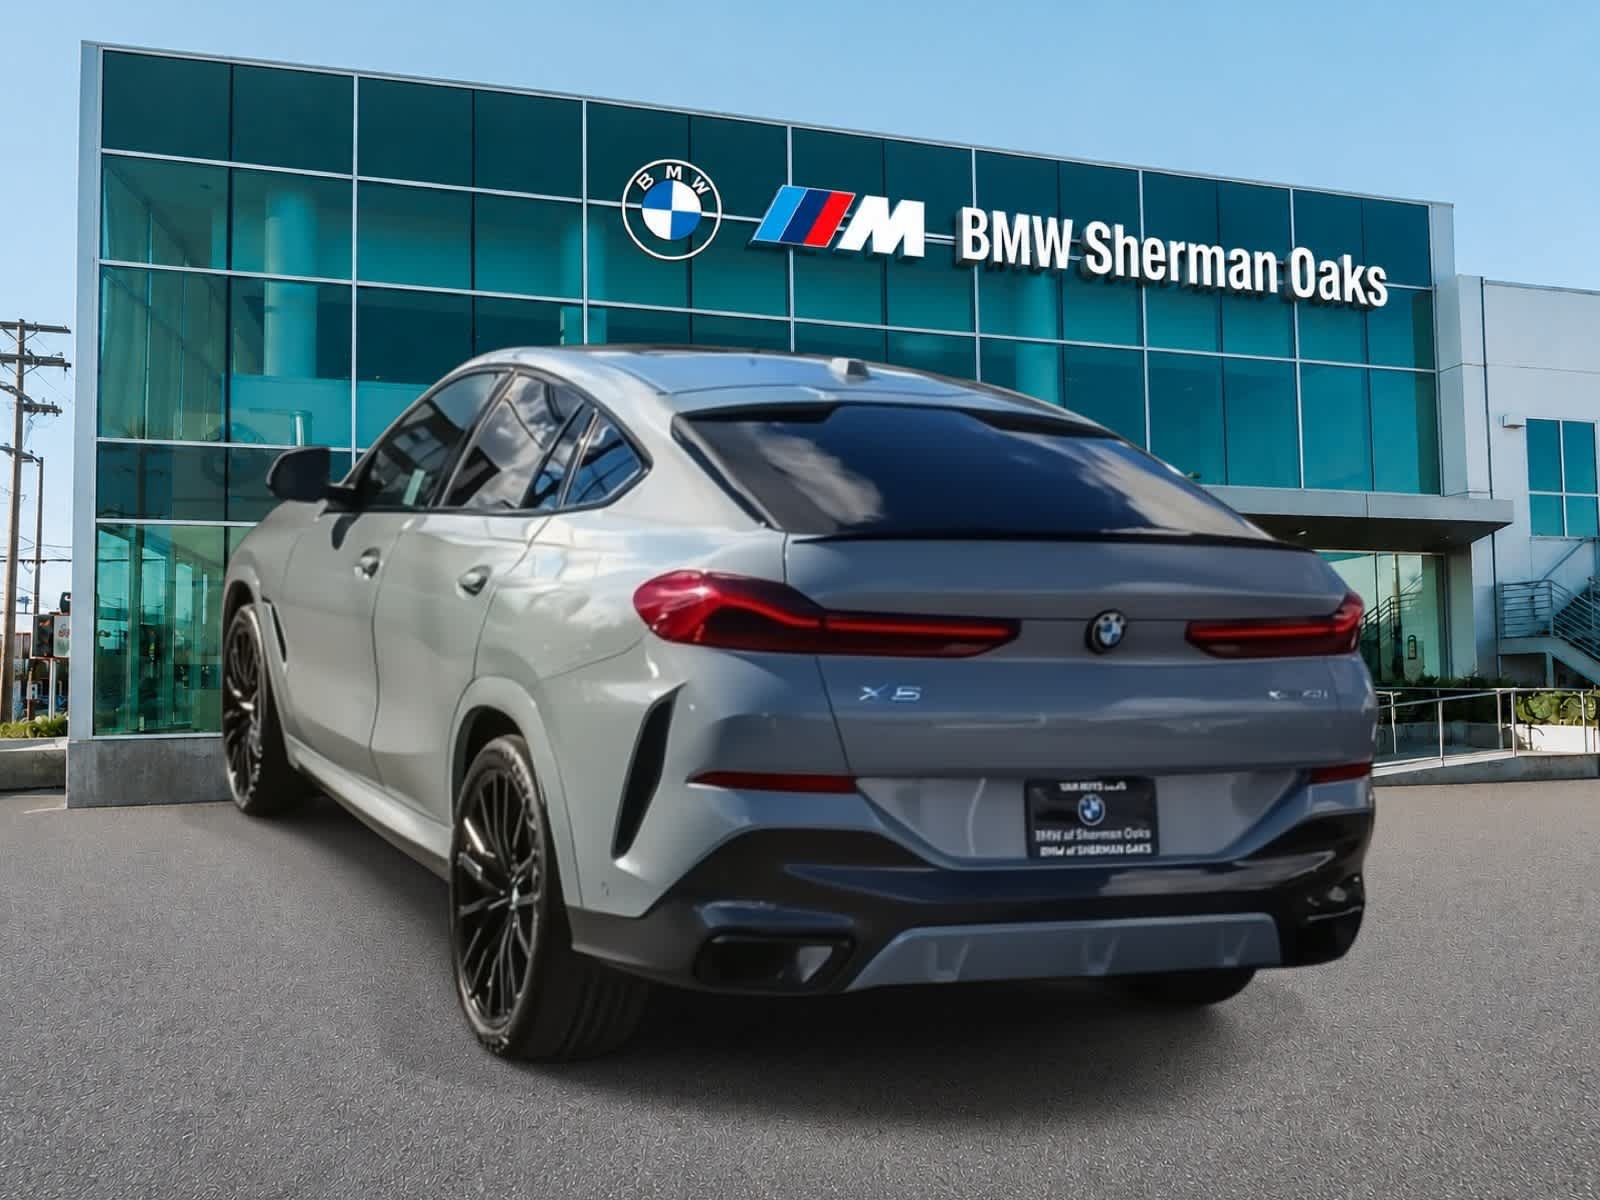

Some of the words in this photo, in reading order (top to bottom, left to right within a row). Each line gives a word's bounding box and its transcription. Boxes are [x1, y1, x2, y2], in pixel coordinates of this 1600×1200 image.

[636, 164, 712, 196] BMW
[836, 194, 925, 258] M
[960, 205, 1074, 271] BMW
[1084, 220, 1279, 294] Sherman
[1289, 246, 1389, 308] Oaks
[1076, 827, 1122, 841] Sherman
